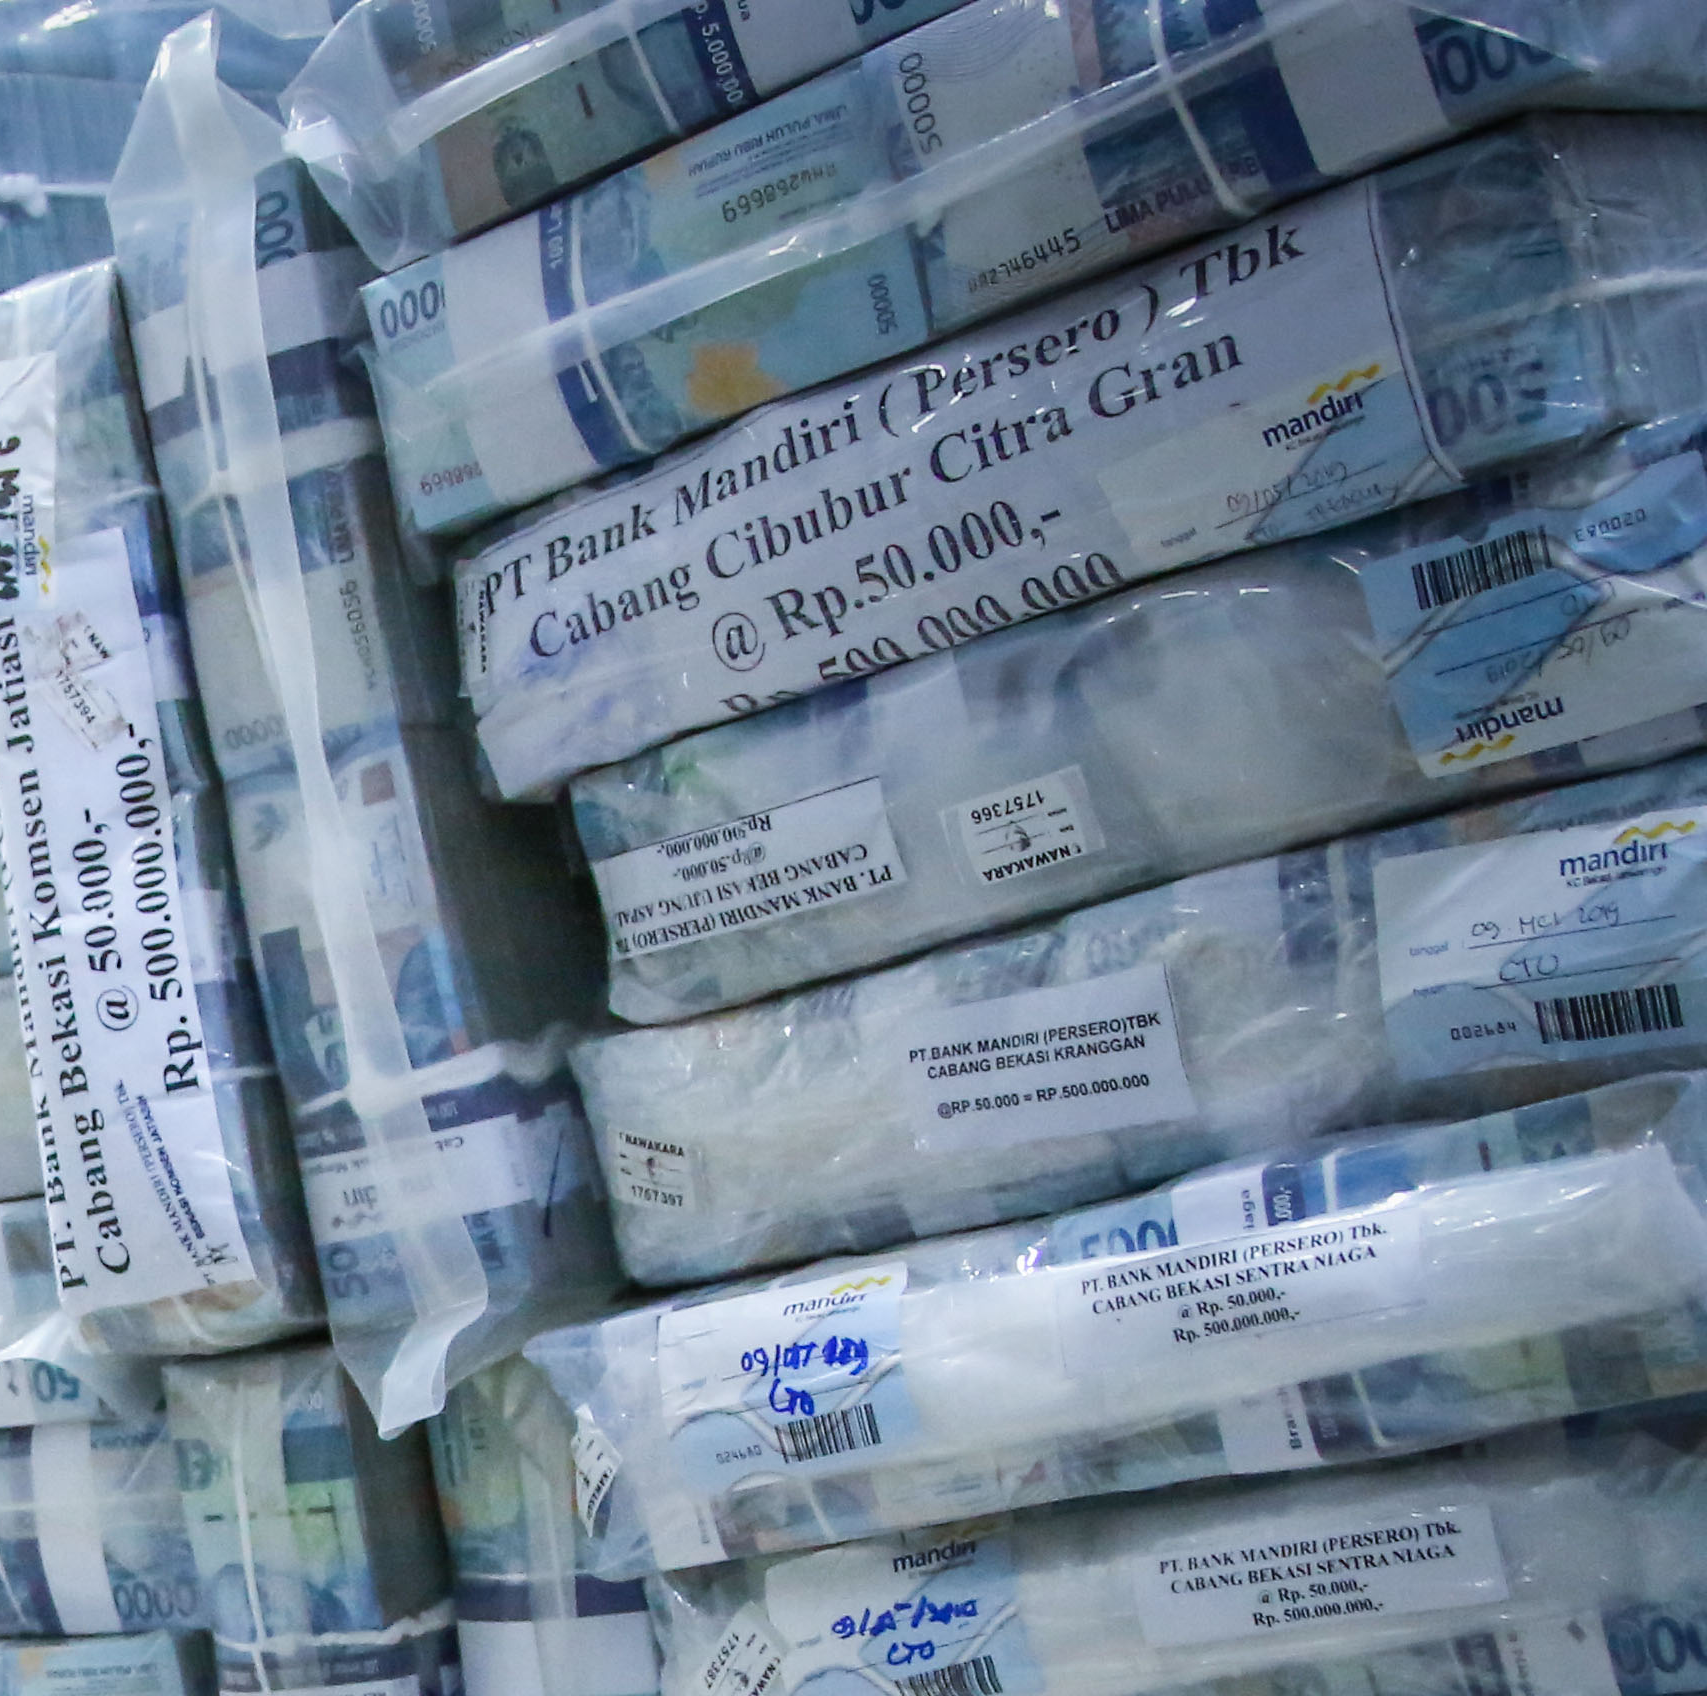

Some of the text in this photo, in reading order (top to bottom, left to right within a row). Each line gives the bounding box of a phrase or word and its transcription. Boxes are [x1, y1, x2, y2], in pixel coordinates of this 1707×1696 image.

[897, 52, 942, 156] 50000
[1104, 194, 1155, 236] LIMA
[484, 223, 1305, 618] PT Bank Mandiri ( Persero ) Tbk
[1262, 390, 1365, 449] mandiri
[530, 330, 1245, 661] Cabang Cibubur Citra Gran
[19, 493, 40, 579] mandiri
[711, 499, 1063, 673] @ Rp.50.000,-
[1455, 696, 1566, 745] mandiri
[969, 788, 1047, 826] 1757366
[13, 751, 62, 945] Komsen
[788, 842, 869, 883] CABANG
[982, 843, 1073, 883] NAWAKARA
[1559, 840, 1669, 878] mandiri
[717, 891, 800, 928] MANDIRI
[800, 874, 860, 907] BANK
[71, 806, 141, 1034] @ 50.000,-
[43, 949, 90, 1101] Bekasi
[908, 1010, 1162, 1065] PT.BANK MANDIRI (PERSERO)TBK
[161, 1014, 202, 1097] Rp.
[926, 1034, 1147, 1081] CABANG BEKASI KRANGGAN
[1035, 1072, 1151, 1103] RP.500.000.000
[75, 1105, 130, 1276] Cabang
[1090, 1244, 1378, 1317] CABANG BEKASI SENTRA NIAGA
[1106, 1264, 1155, 1292] BANK
[1154, 1248, 1239, 1281] MANDIRI
[1241, 1230, 1346, 1265] (PERSERO)
[1349, 1223, 1388, 1243] Tbk.
[1196, 1296, 1224, 1319] Rp.
[1226, 1285, 1288, 1312] 50.000,-
[1172, 1324, 1200, 1347] Rp.
[892, 1540, 977, 1574] mandiri
[1169, 1543, 1456, 1596] CABANG BEKASI SENTRA NIAGA
[1186, 1550, 1236, 1574] BANK
[1238, 1536, 1320, 1565] MANDIRI
[1322, 1524, 1421, 1557] (PERSERO)
[1423, 1519, 1463, 1538] Tbk.
[1277, 1585, 1306, 1604] Rp.
[1308, 1577, 1370, 1599] 50.000,-
[1251, 1610, 1281, 1630] Rp.
